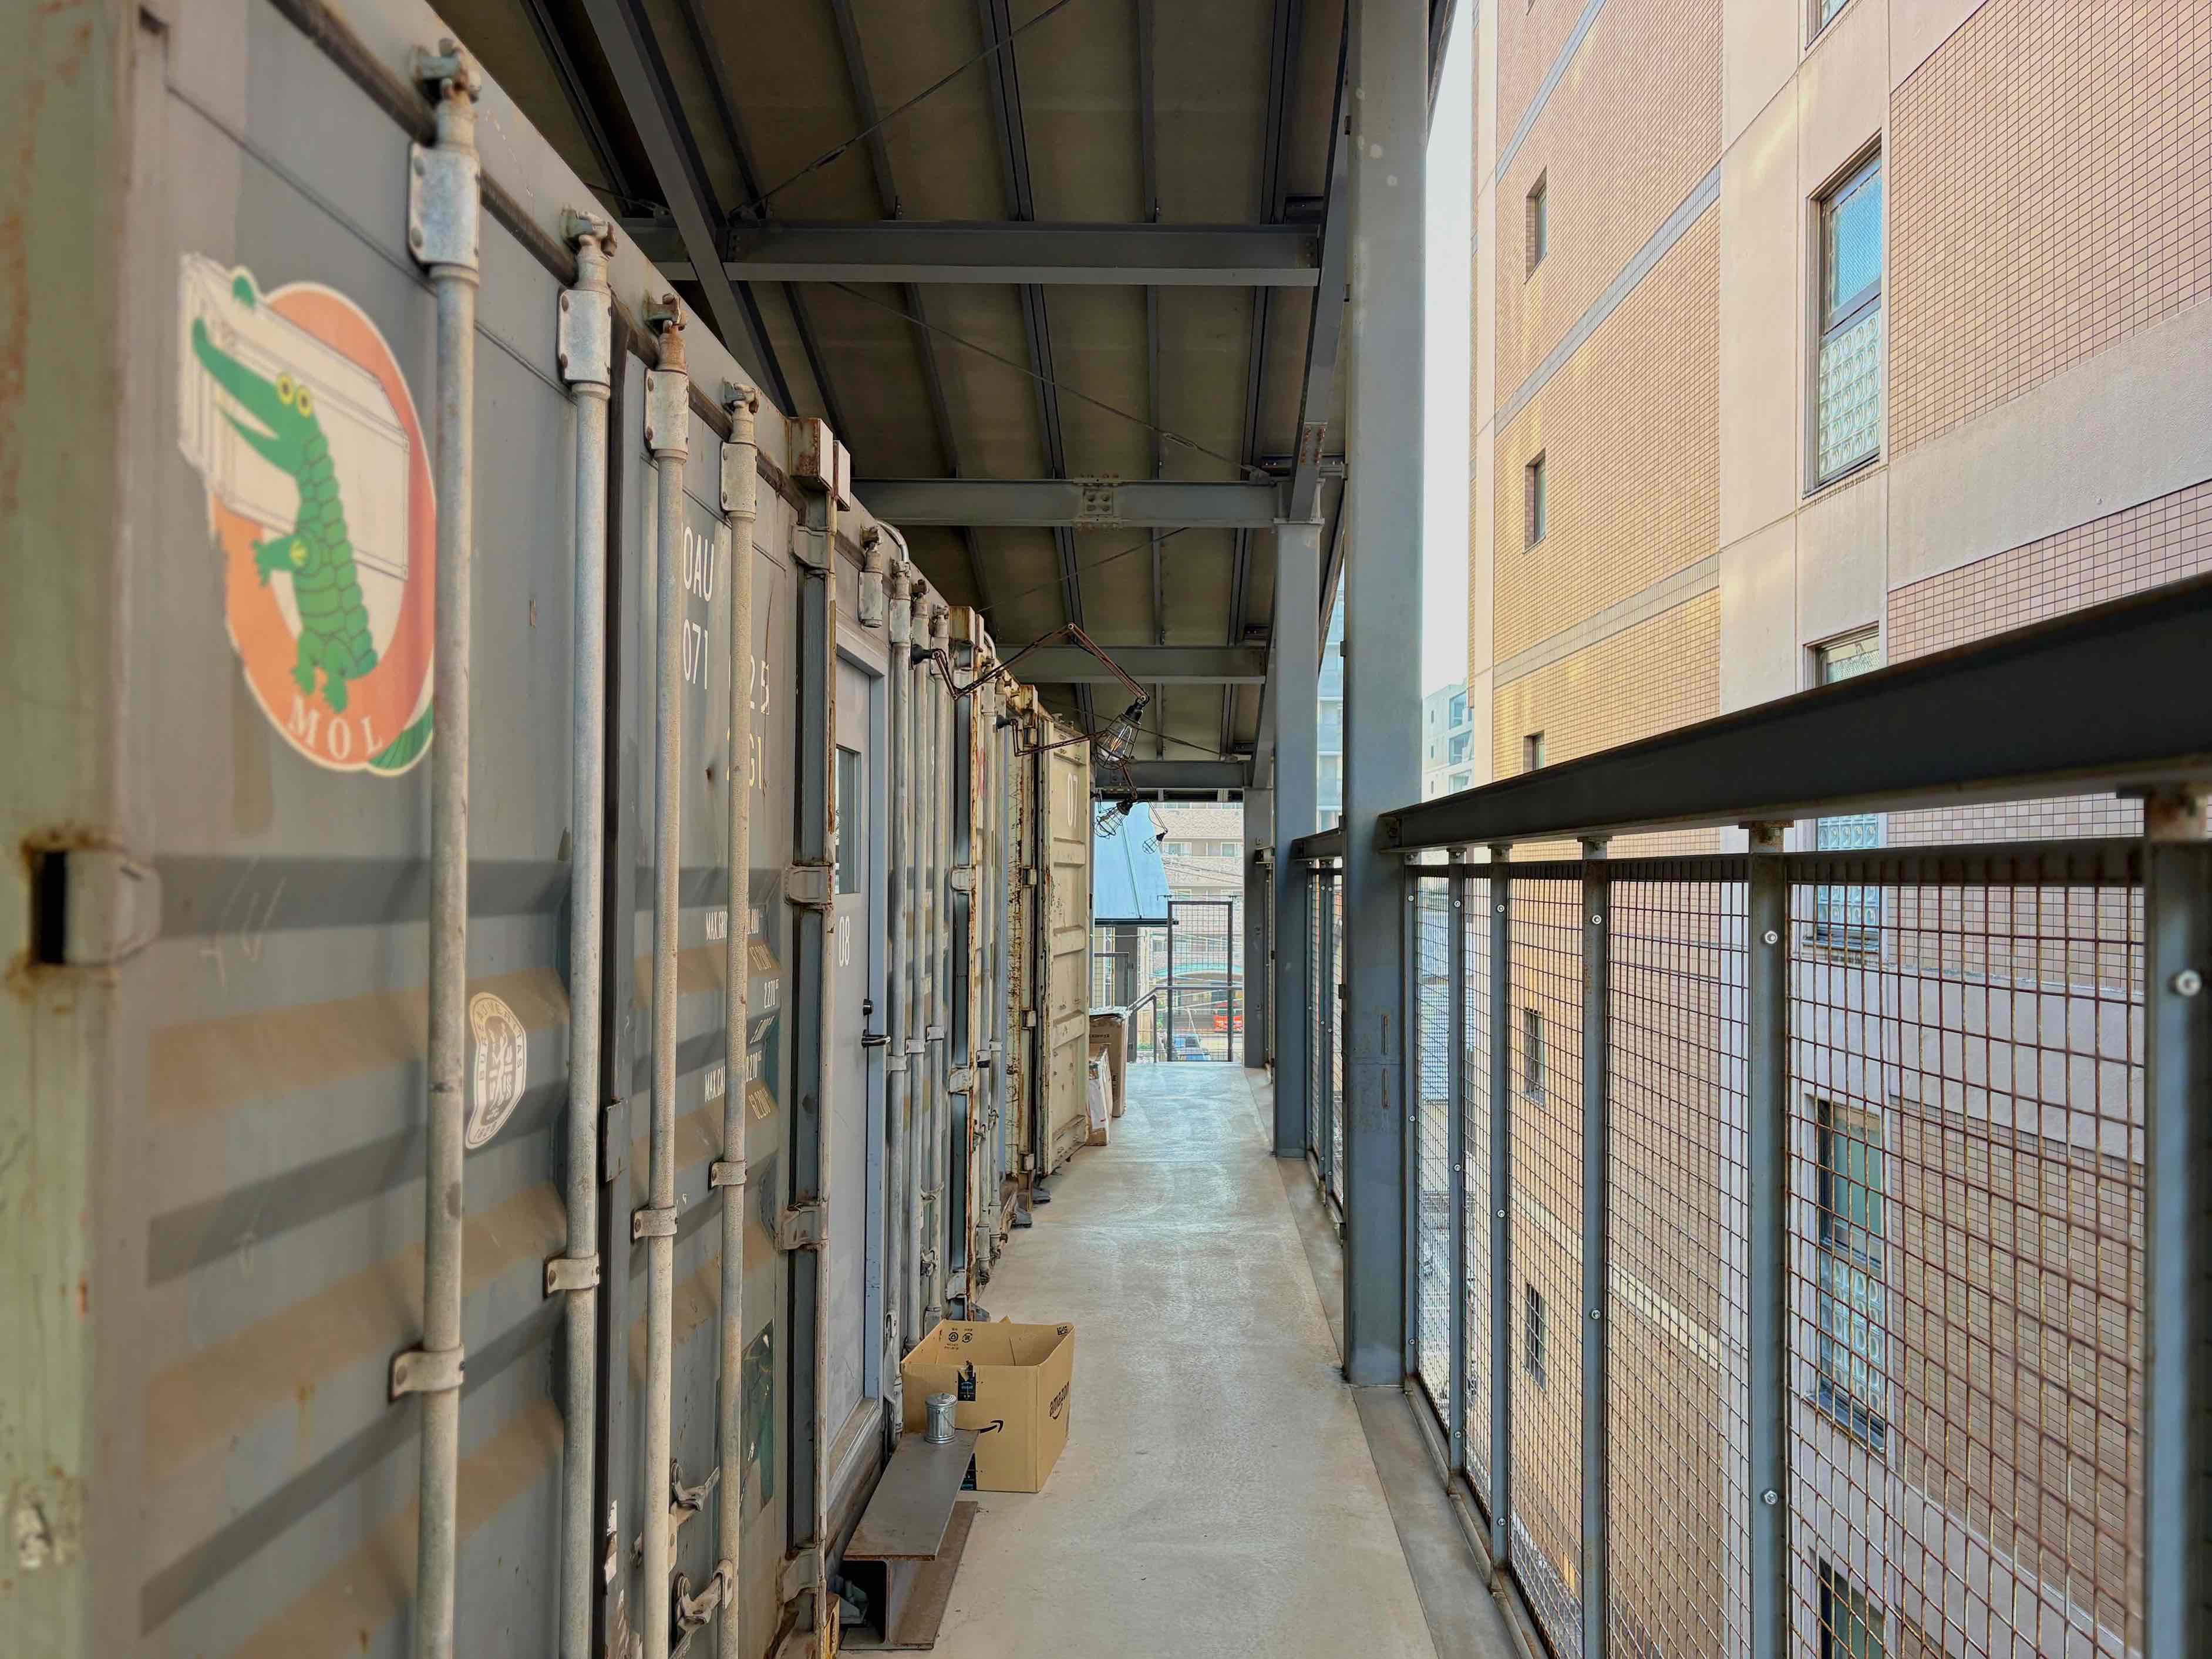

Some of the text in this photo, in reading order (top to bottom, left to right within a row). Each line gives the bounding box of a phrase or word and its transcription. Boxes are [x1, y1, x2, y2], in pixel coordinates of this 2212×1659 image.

[681, 521, 715, 601] OAU
[682, 619, 708, 689] 071
[287, 694, 383, 760] MOL
[705, 911, 728, 940] MAX.GRO
[839, 915, 850, 967] 08
[1049, 1381, 1069, 1417] amazon
